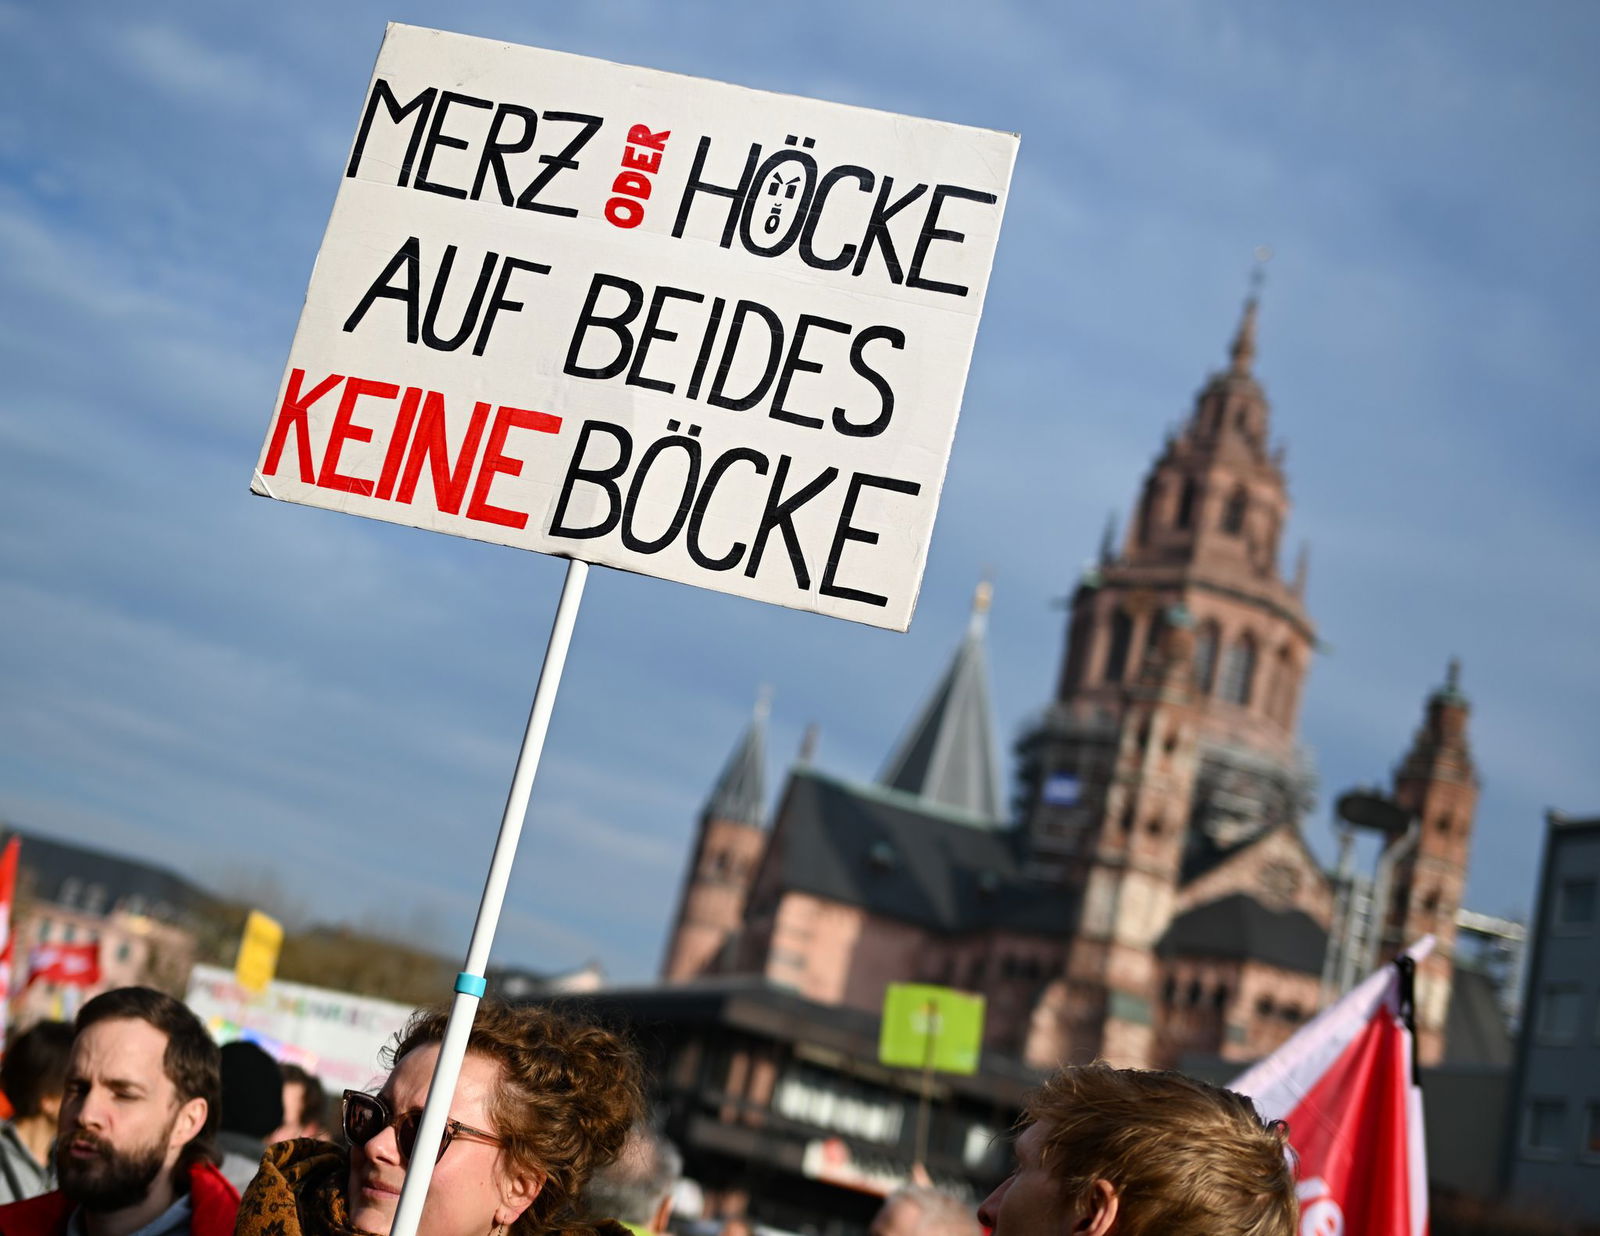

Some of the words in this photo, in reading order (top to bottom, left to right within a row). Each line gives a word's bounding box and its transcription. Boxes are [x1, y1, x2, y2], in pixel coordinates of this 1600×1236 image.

[346, 78, 604, 218] MERZ
[604, 123, 671, 229] ODER
[671, 134, 998, 297] HÖCKE
[342, 236, 552, 357] AUF
[563, 272, 906, 438] BEIDES
[262, 367, 563, 530] KEINE
[549, 418, 921, 607] BÖCKE
